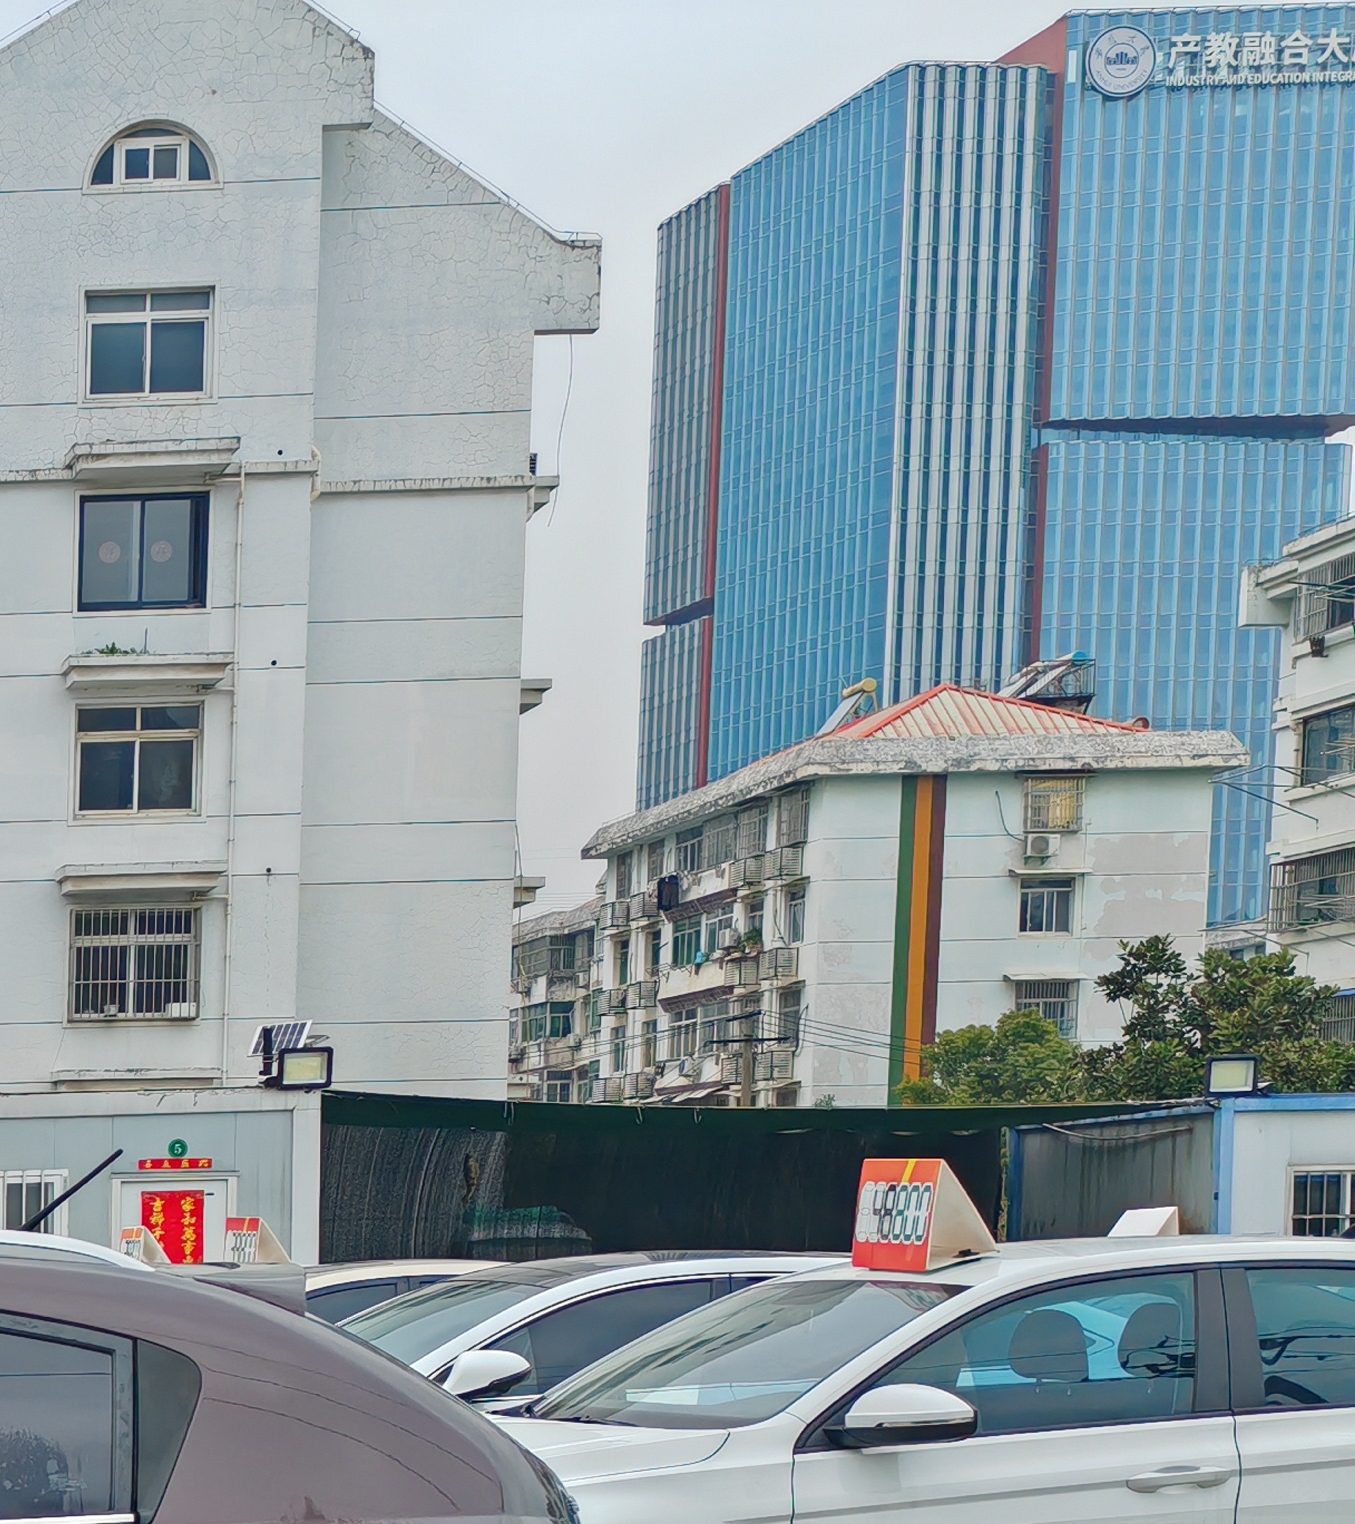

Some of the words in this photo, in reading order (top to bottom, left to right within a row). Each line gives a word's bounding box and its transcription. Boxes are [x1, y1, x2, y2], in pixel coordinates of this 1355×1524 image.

[1168, 28, 1355, 69] 产教融合大
[1166, 74, 1221, 87] INDUSTRY
[1248, 71, 1310, 85] EDUCATION
[1312, 70, 1355, 83] INTEGR
[173, 1143, 183, 1154] 5
